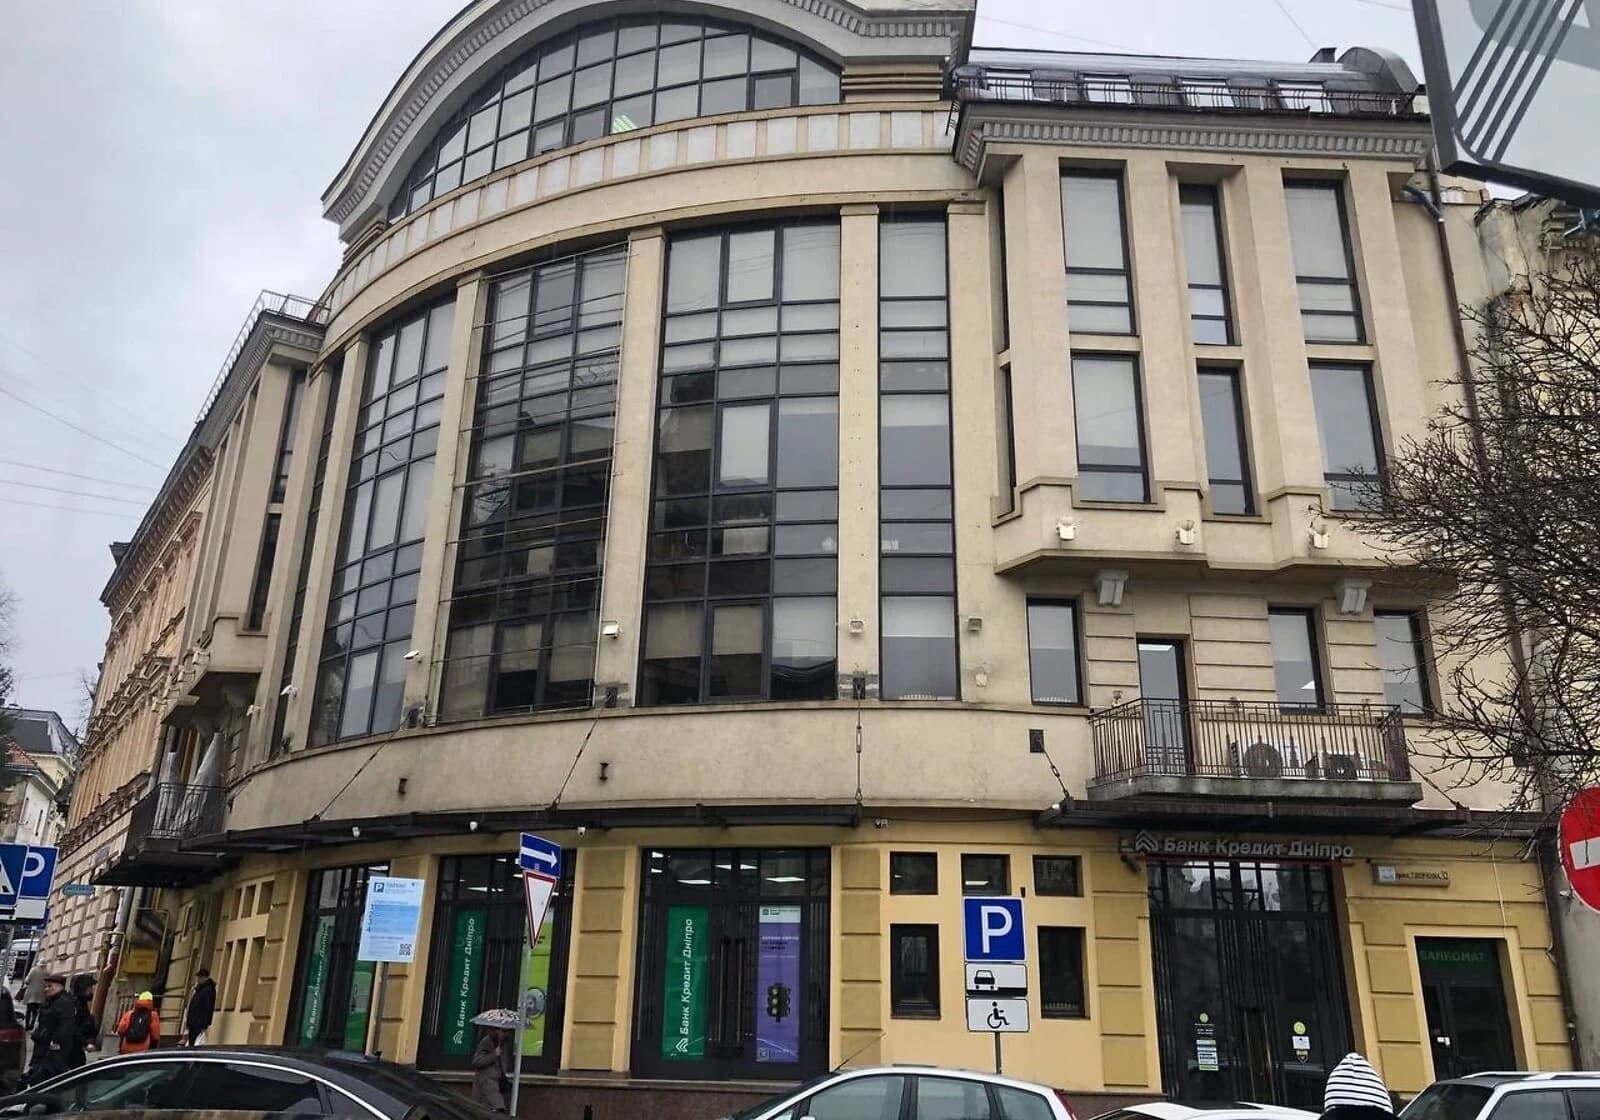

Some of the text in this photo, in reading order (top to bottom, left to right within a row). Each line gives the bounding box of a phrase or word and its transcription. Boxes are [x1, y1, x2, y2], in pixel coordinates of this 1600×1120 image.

[1163, 837, 1354, 859] Банк Кредит Дніпро
[981, 906, 1012, 953] P
[457, 918, 475, 1027] Банк Кредит Дніпро
[680, 918, 694, 1035] Банк Кредит Дніпро
